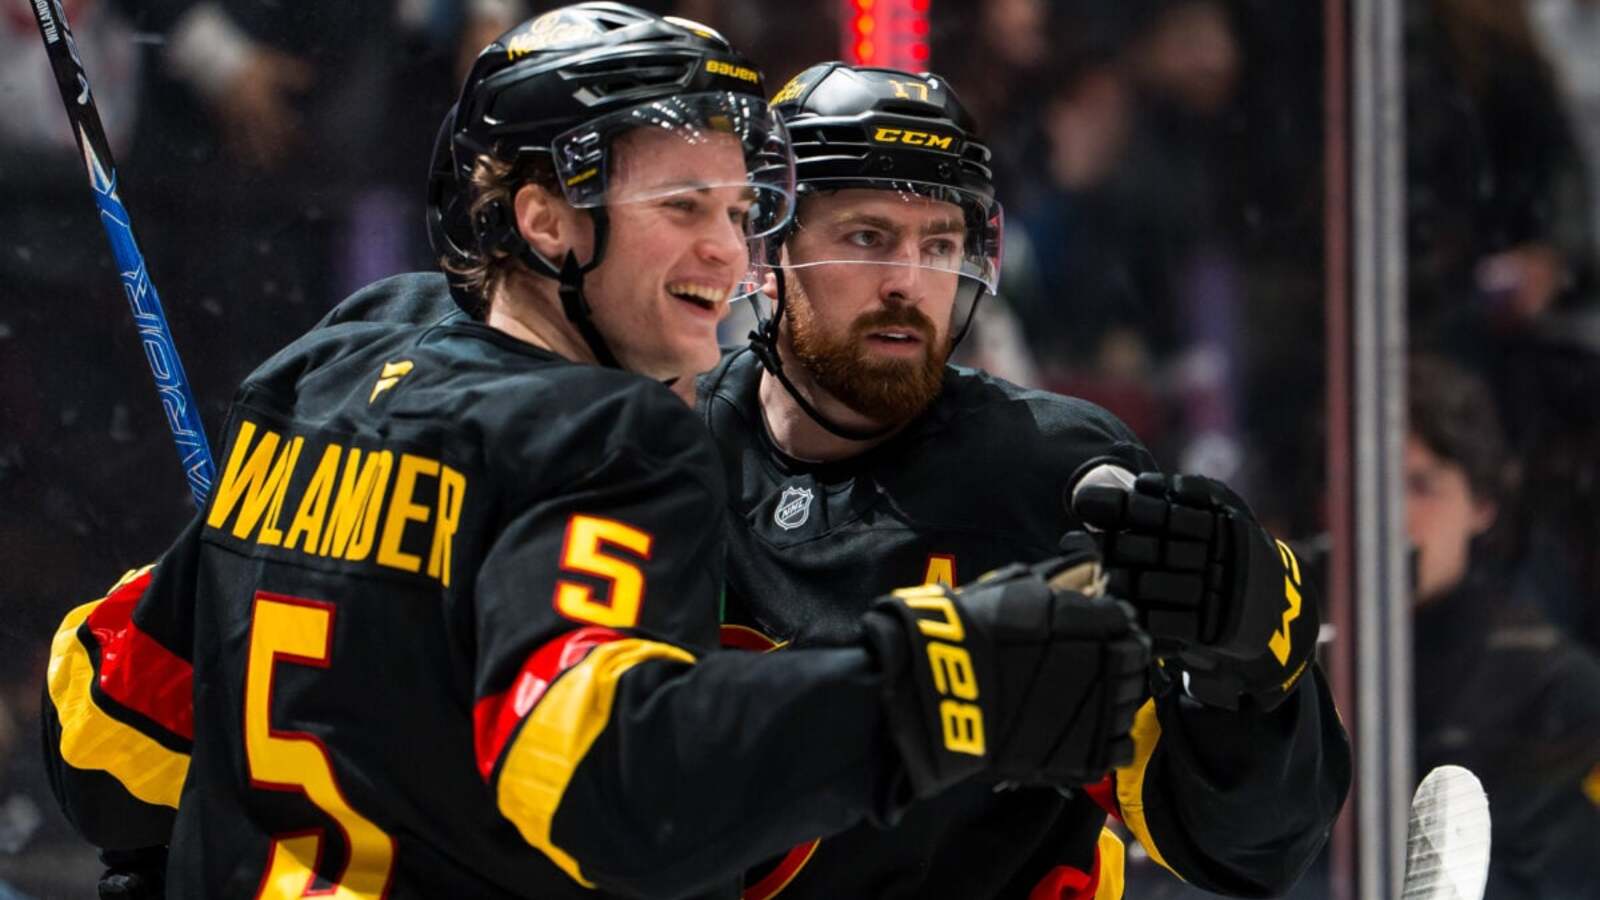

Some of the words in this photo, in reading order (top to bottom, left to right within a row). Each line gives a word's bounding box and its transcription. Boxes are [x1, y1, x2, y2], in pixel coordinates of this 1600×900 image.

[34, 0, 60, 44] WILLAND
[888, 80, 928, 102] 17
[874, 128, 953, 149] CCM
[552, 513, 655, 627] 5
[891, 583, 986, 757] BAU
[243, 590, 397, 900] 5
